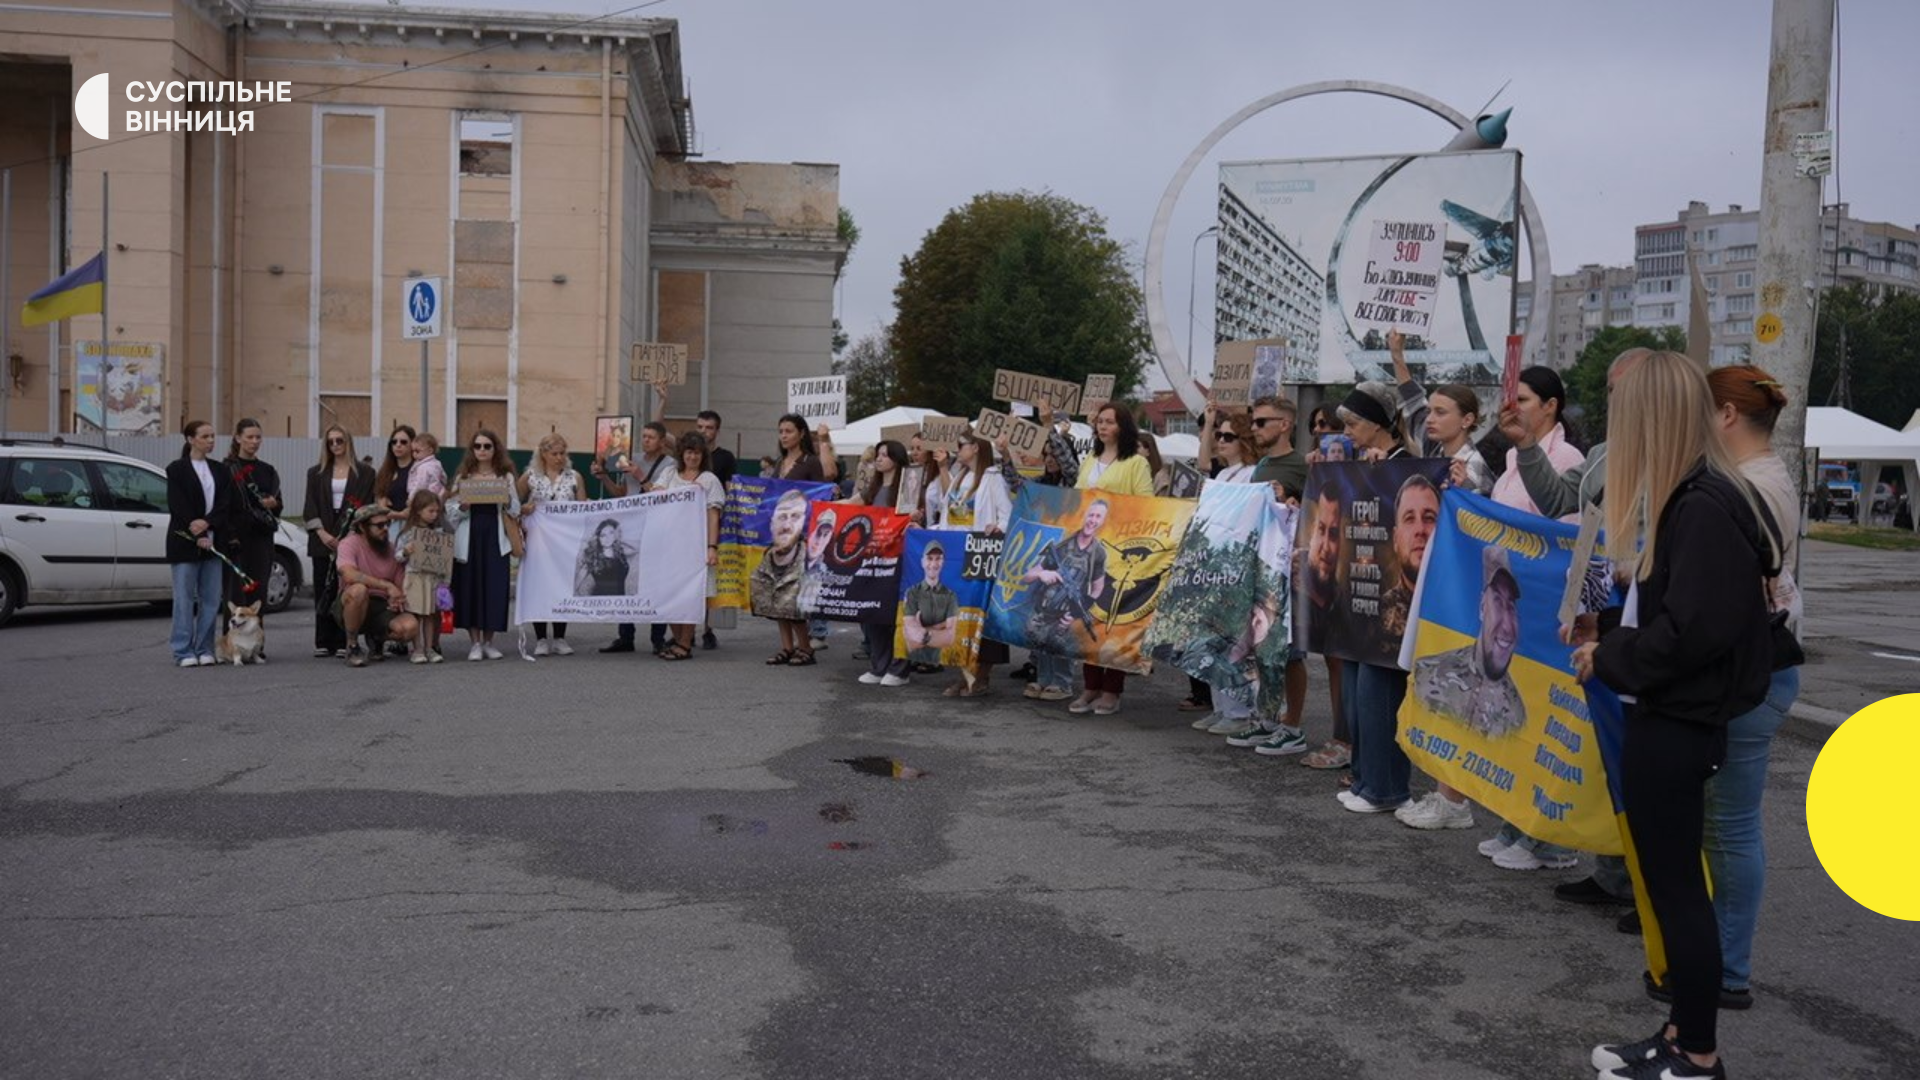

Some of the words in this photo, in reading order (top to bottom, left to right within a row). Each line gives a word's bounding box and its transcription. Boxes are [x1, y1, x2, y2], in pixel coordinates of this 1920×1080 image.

[1393, 241, 1421, 262] 9:00
[411, 325, 433, 336] ЗОНА
[631, 365, 650, 381] ЦЕ
[996, 373, 1078, 413] ВШАНУЙ
[980, 412, 1038, 450] 09:00
[1352, 497, 1381, 522] ГЕРОЇ
[1116, 519, 1173, 538] ДЗИГА
